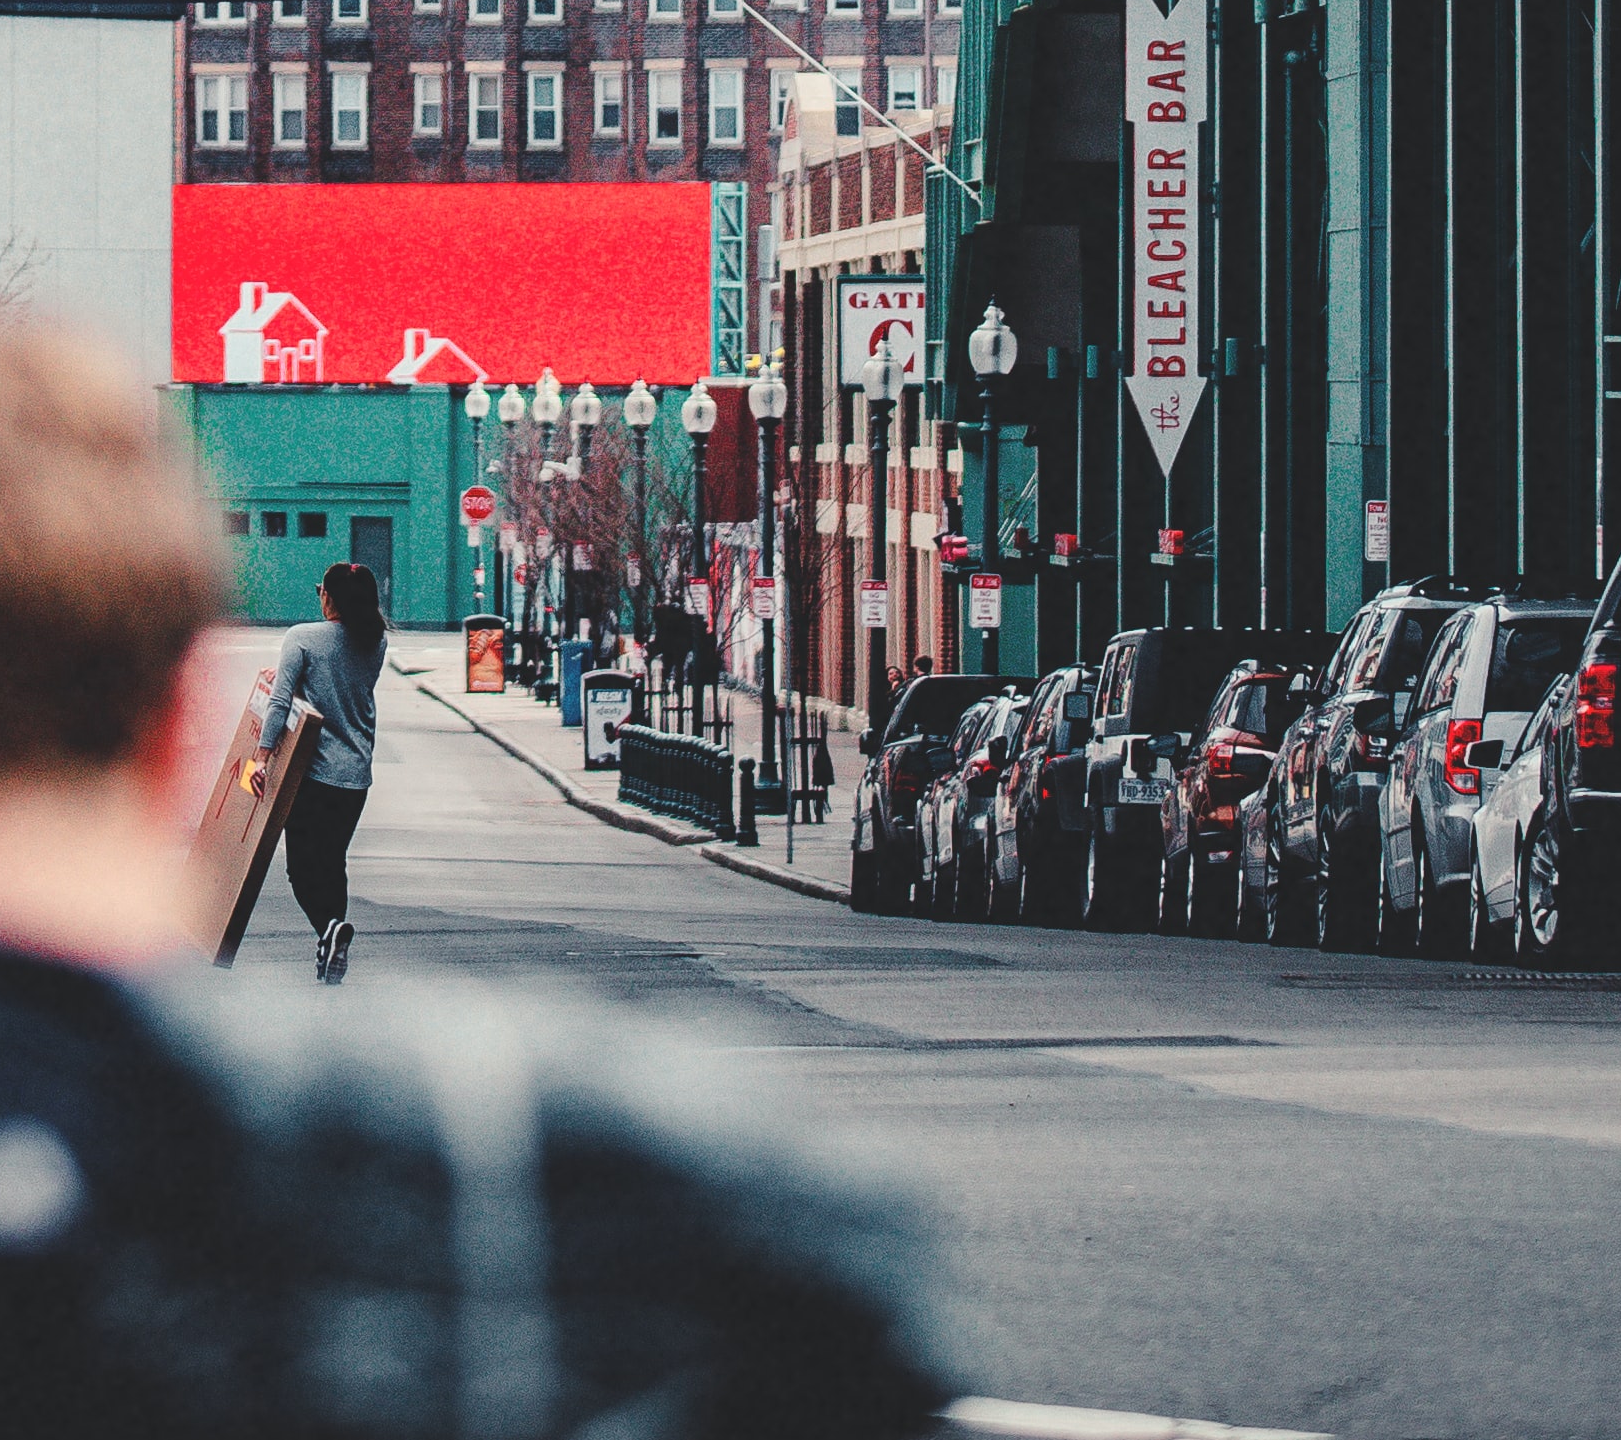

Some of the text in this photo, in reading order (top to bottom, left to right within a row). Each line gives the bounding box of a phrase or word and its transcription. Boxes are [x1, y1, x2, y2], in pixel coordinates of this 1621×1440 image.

[1147, 39, 1187, 433] the BLEACHER BAR
[463, 495, 495, 511] STOP
